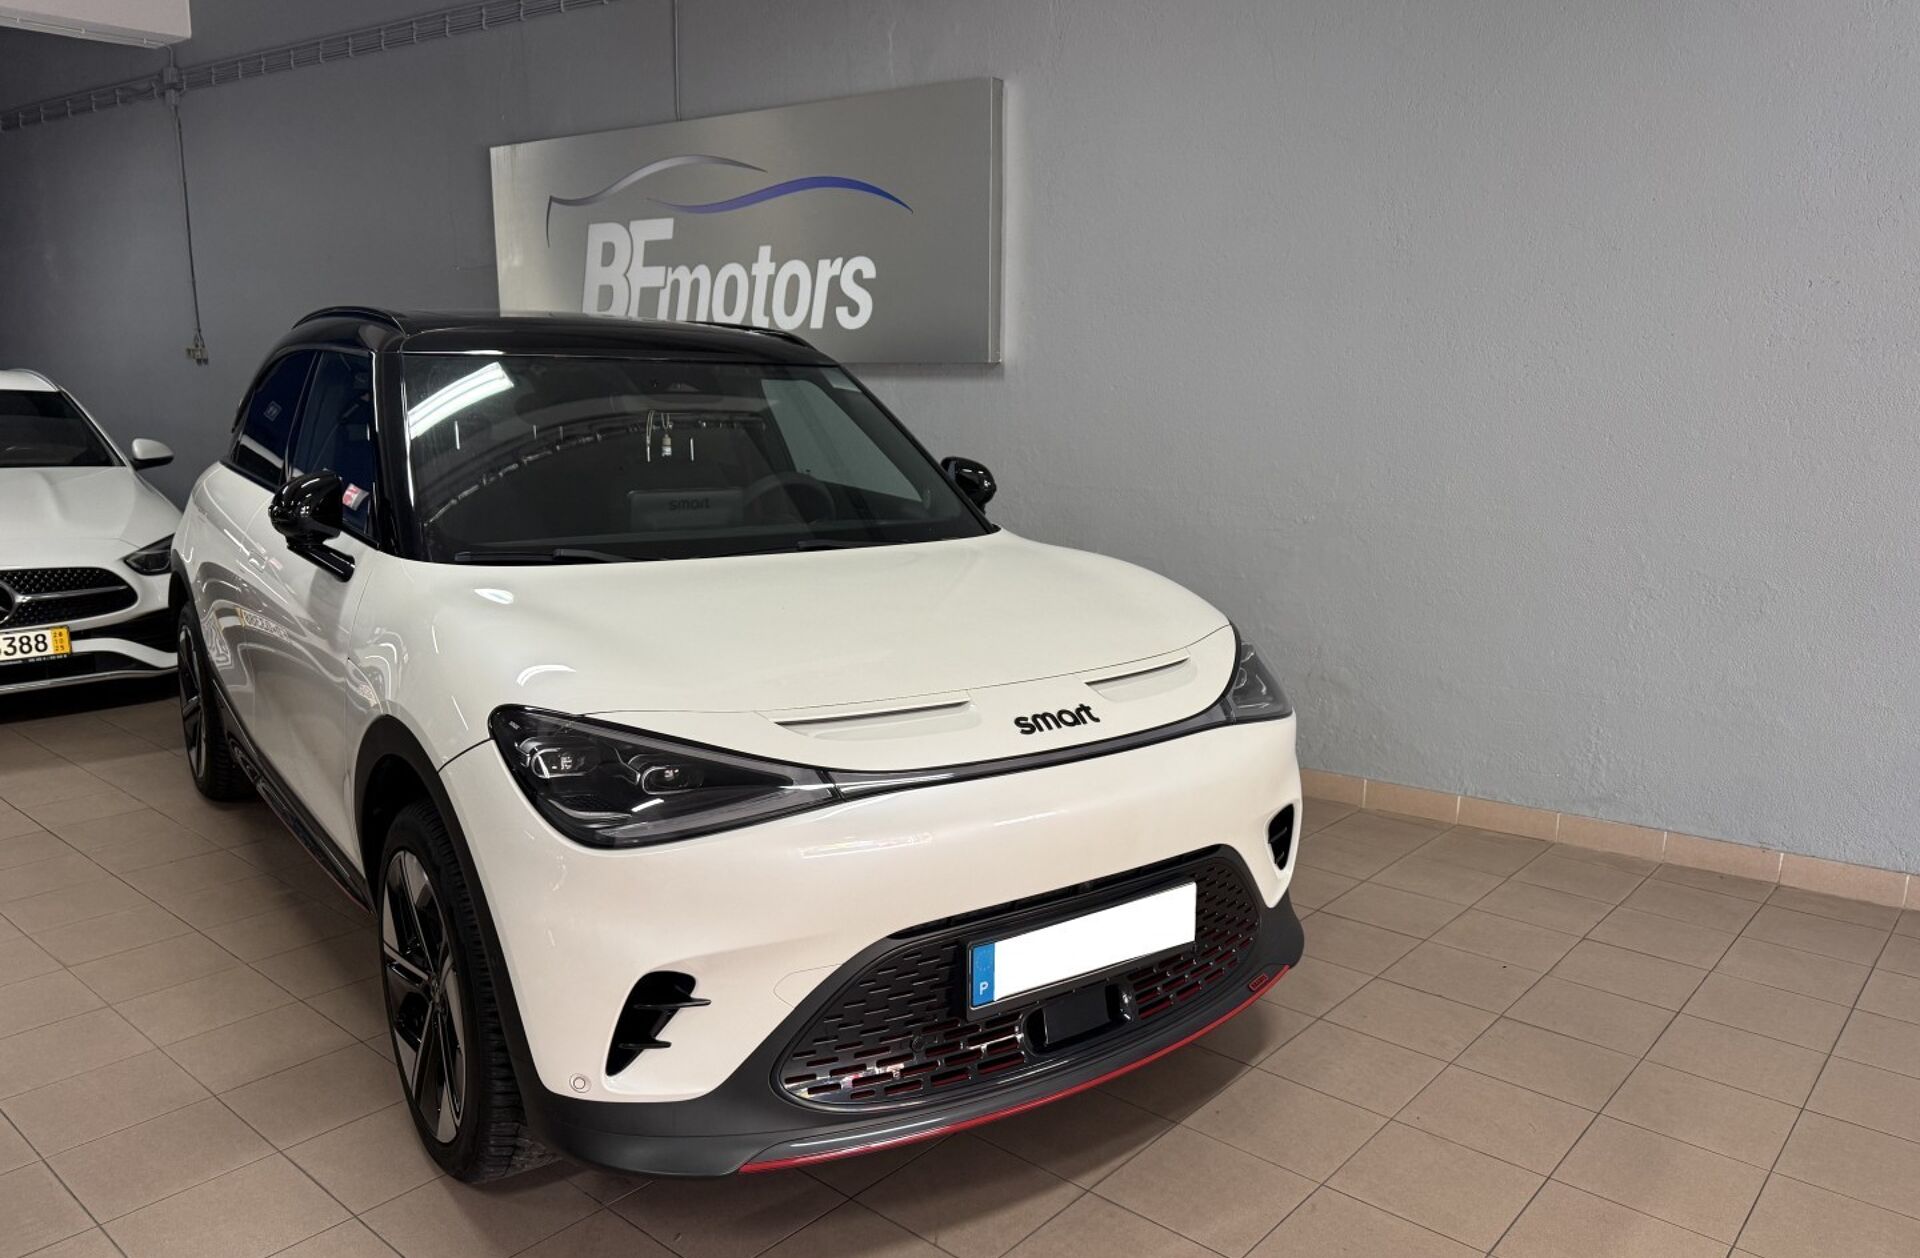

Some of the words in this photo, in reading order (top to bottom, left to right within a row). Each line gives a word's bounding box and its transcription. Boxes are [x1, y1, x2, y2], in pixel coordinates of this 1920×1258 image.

[668, 497, 711, 511] smart
[0, 633, 48, 656] 388
[1014, 703, 1101, 735] smart
[979, 981, 989, 996] P
